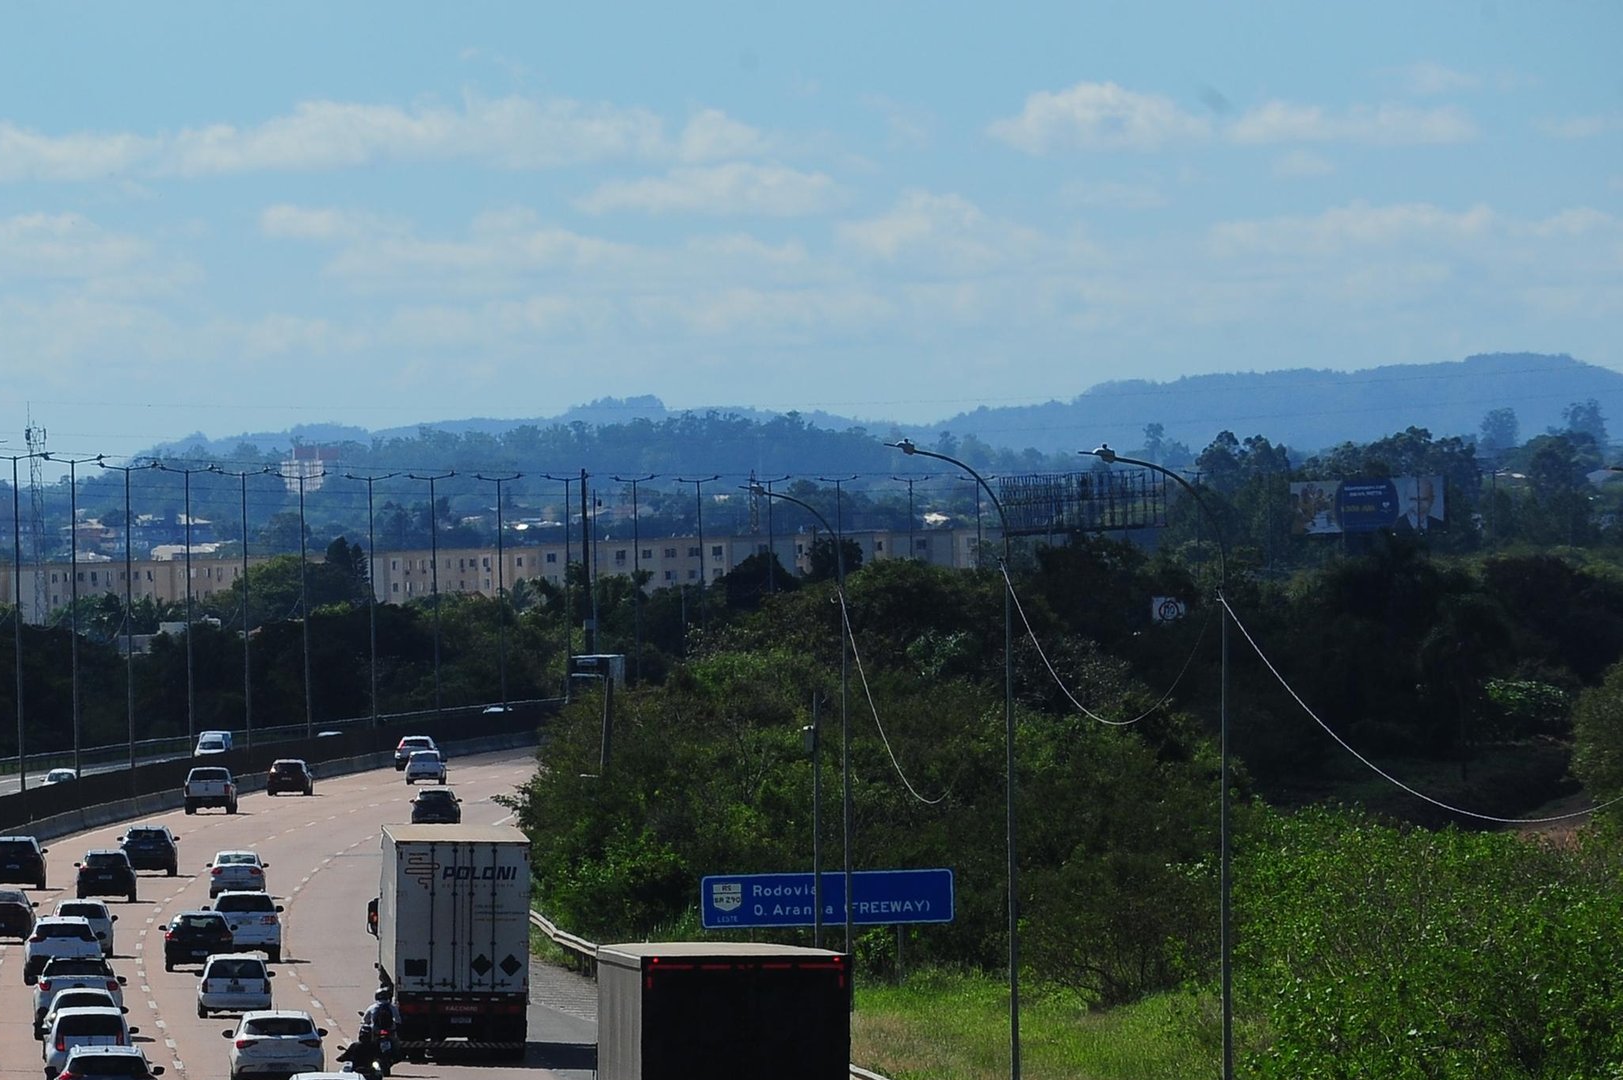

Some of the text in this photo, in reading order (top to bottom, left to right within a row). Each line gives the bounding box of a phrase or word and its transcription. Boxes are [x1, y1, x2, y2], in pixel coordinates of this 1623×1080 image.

[442, 866, 517, 880] POLONI
[754, 904, 768, 916] O.
[773, 904, 834, 916] Arana
